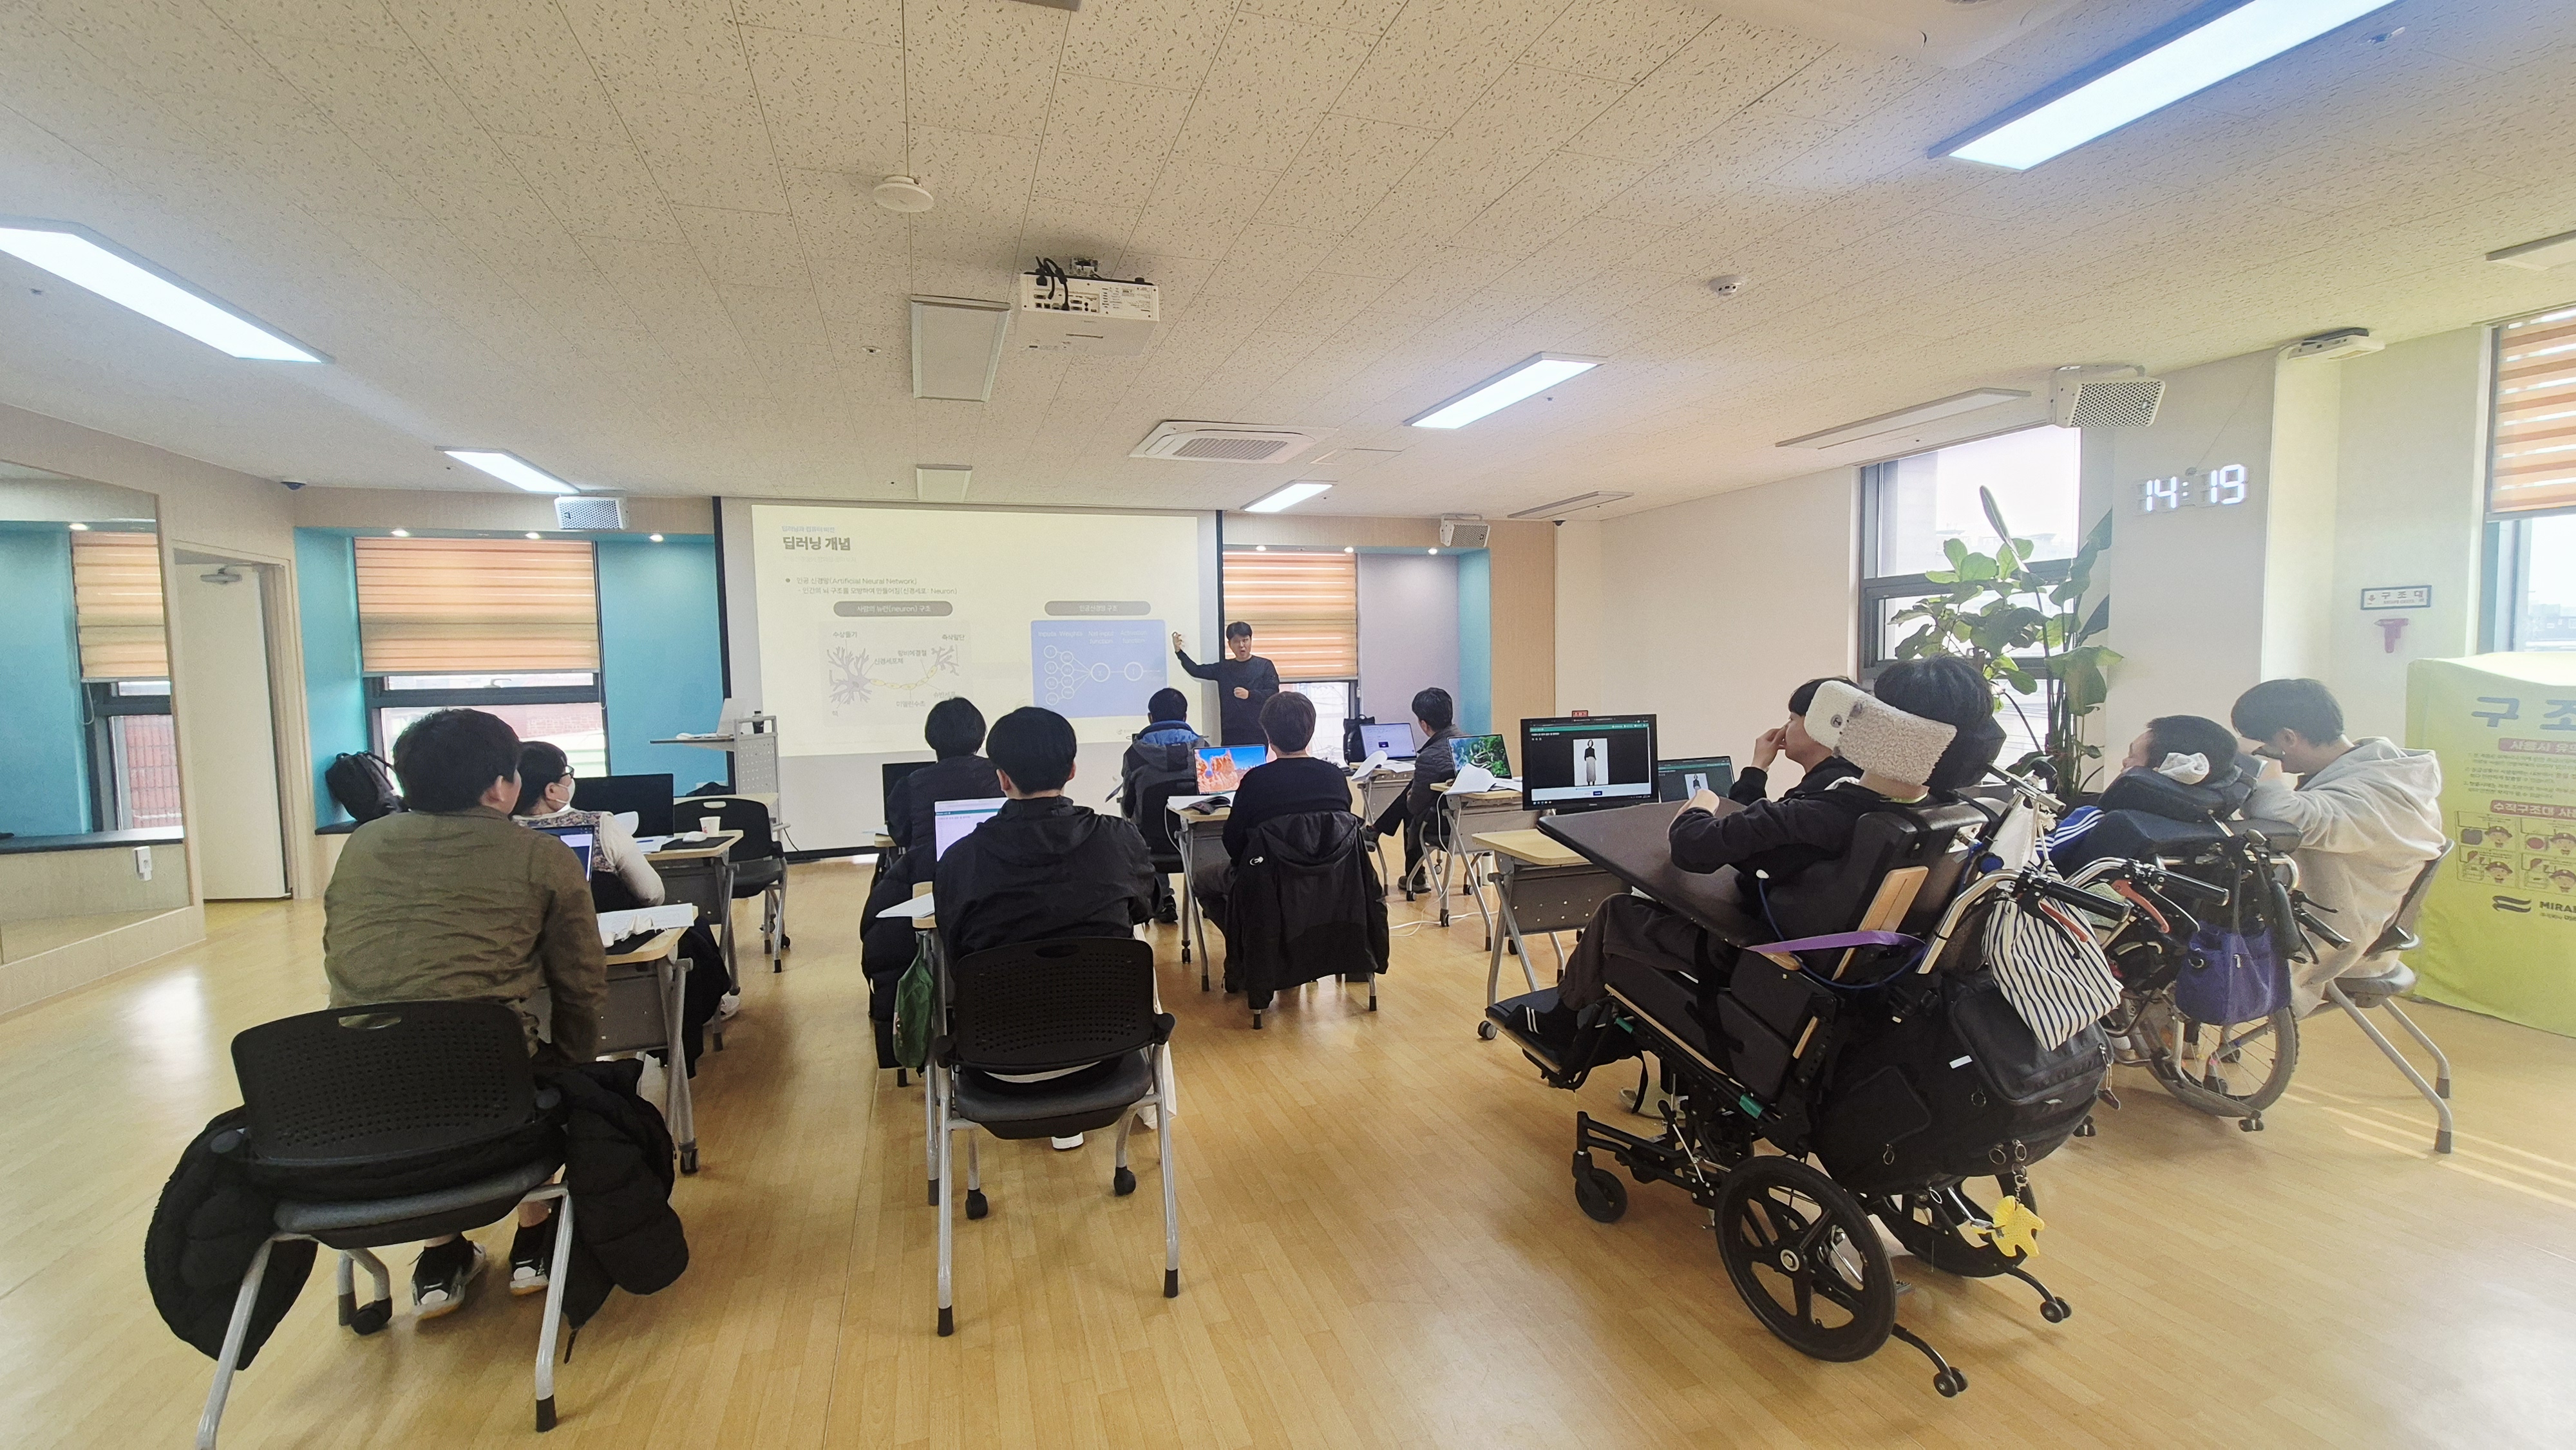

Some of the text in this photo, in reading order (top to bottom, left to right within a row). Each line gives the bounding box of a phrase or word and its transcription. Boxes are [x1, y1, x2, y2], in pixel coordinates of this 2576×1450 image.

[2146, 464, 2246, 512] 14:19
[782, 536, 851, 551] 딥러닝 개념
[2510, 741, 2550, 752] 사용시
[2494, 803, 2554, 816] 수직구조대
